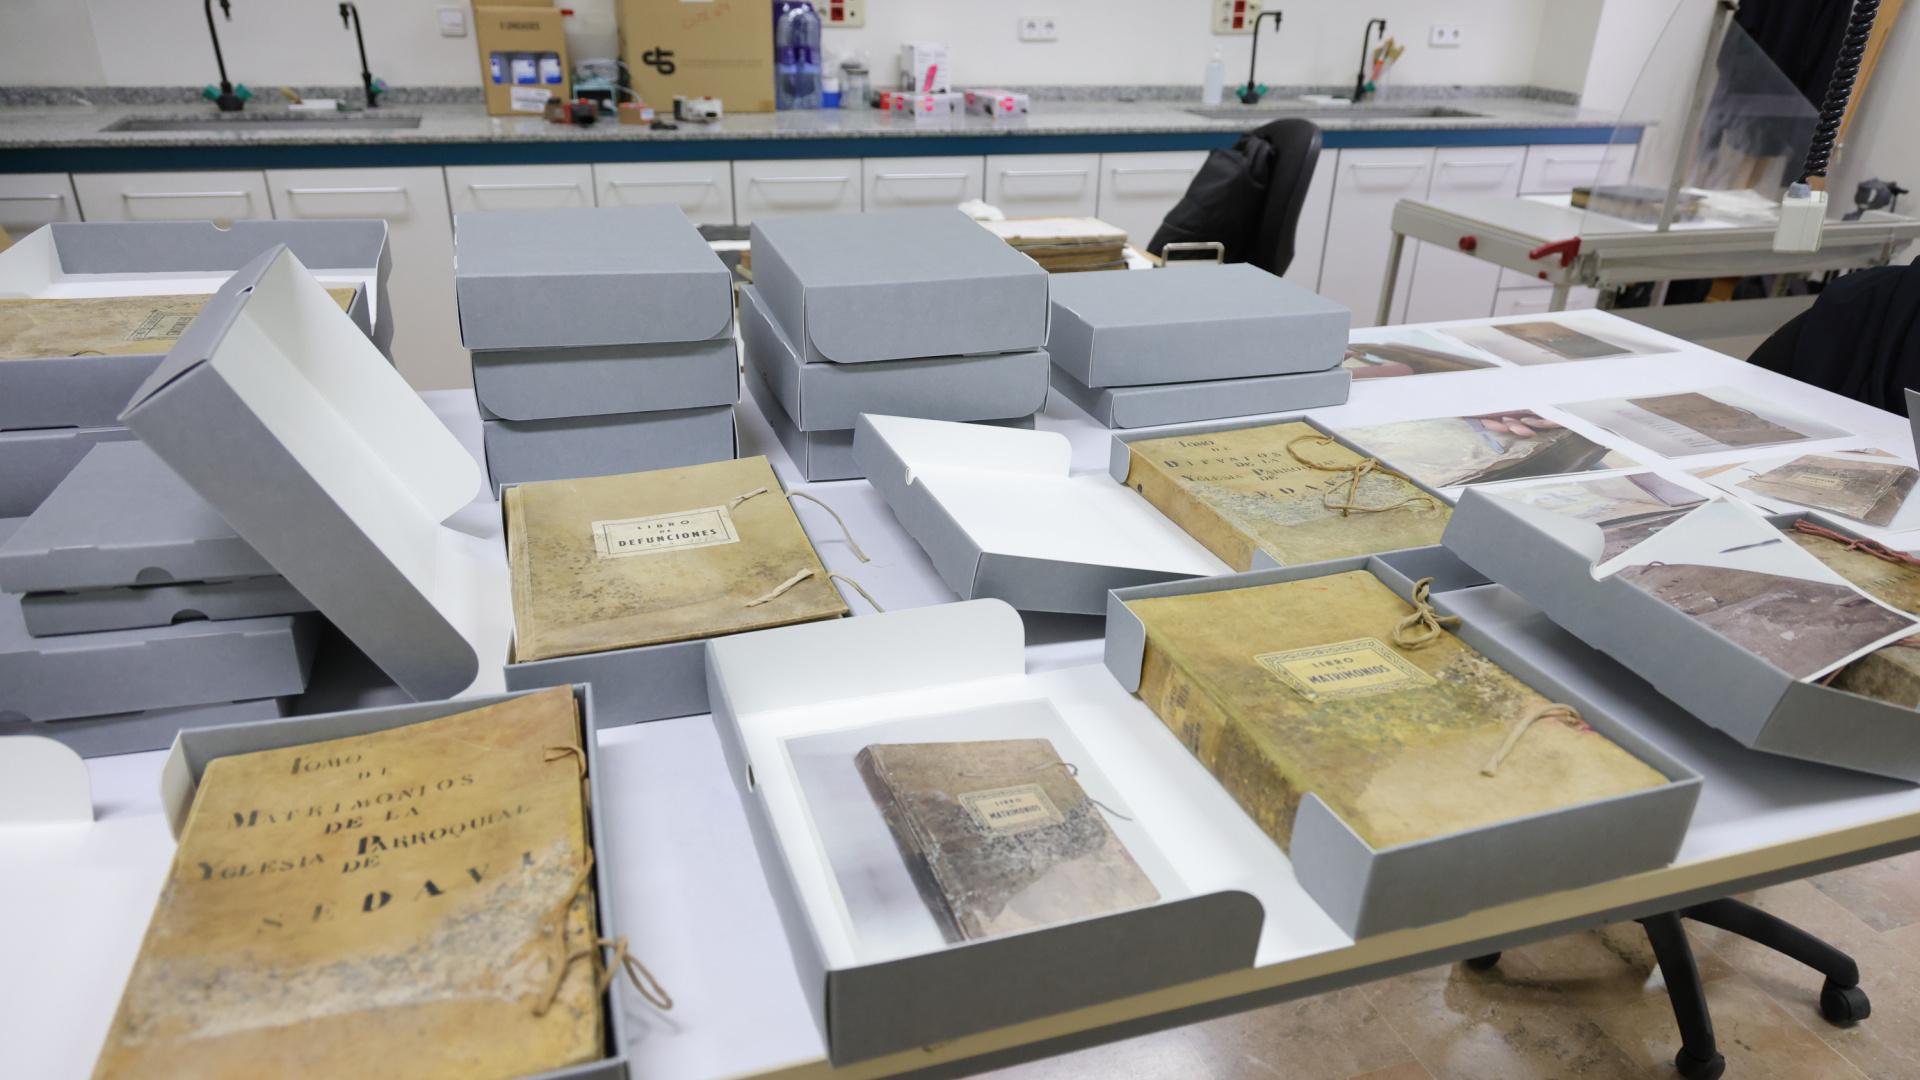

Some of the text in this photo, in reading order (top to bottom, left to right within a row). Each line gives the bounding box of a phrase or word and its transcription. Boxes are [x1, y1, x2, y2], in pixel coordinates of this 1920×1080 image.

[637, 520, 690, 530] LIBRO
[618, 529, 718, 547] DEFUNCIONES
[1312, 657, 1354, 668] LIBRO
[1308, 665, 1391, 684] MATRIMONIOS
[229, 774, 475, 829] MATRIMONIOS
[324, 805, 420, 835] DE LA
[197, 804, 532, 880] YGLESIA PARROQUIAL
[341, 854, 381, 874] DE
